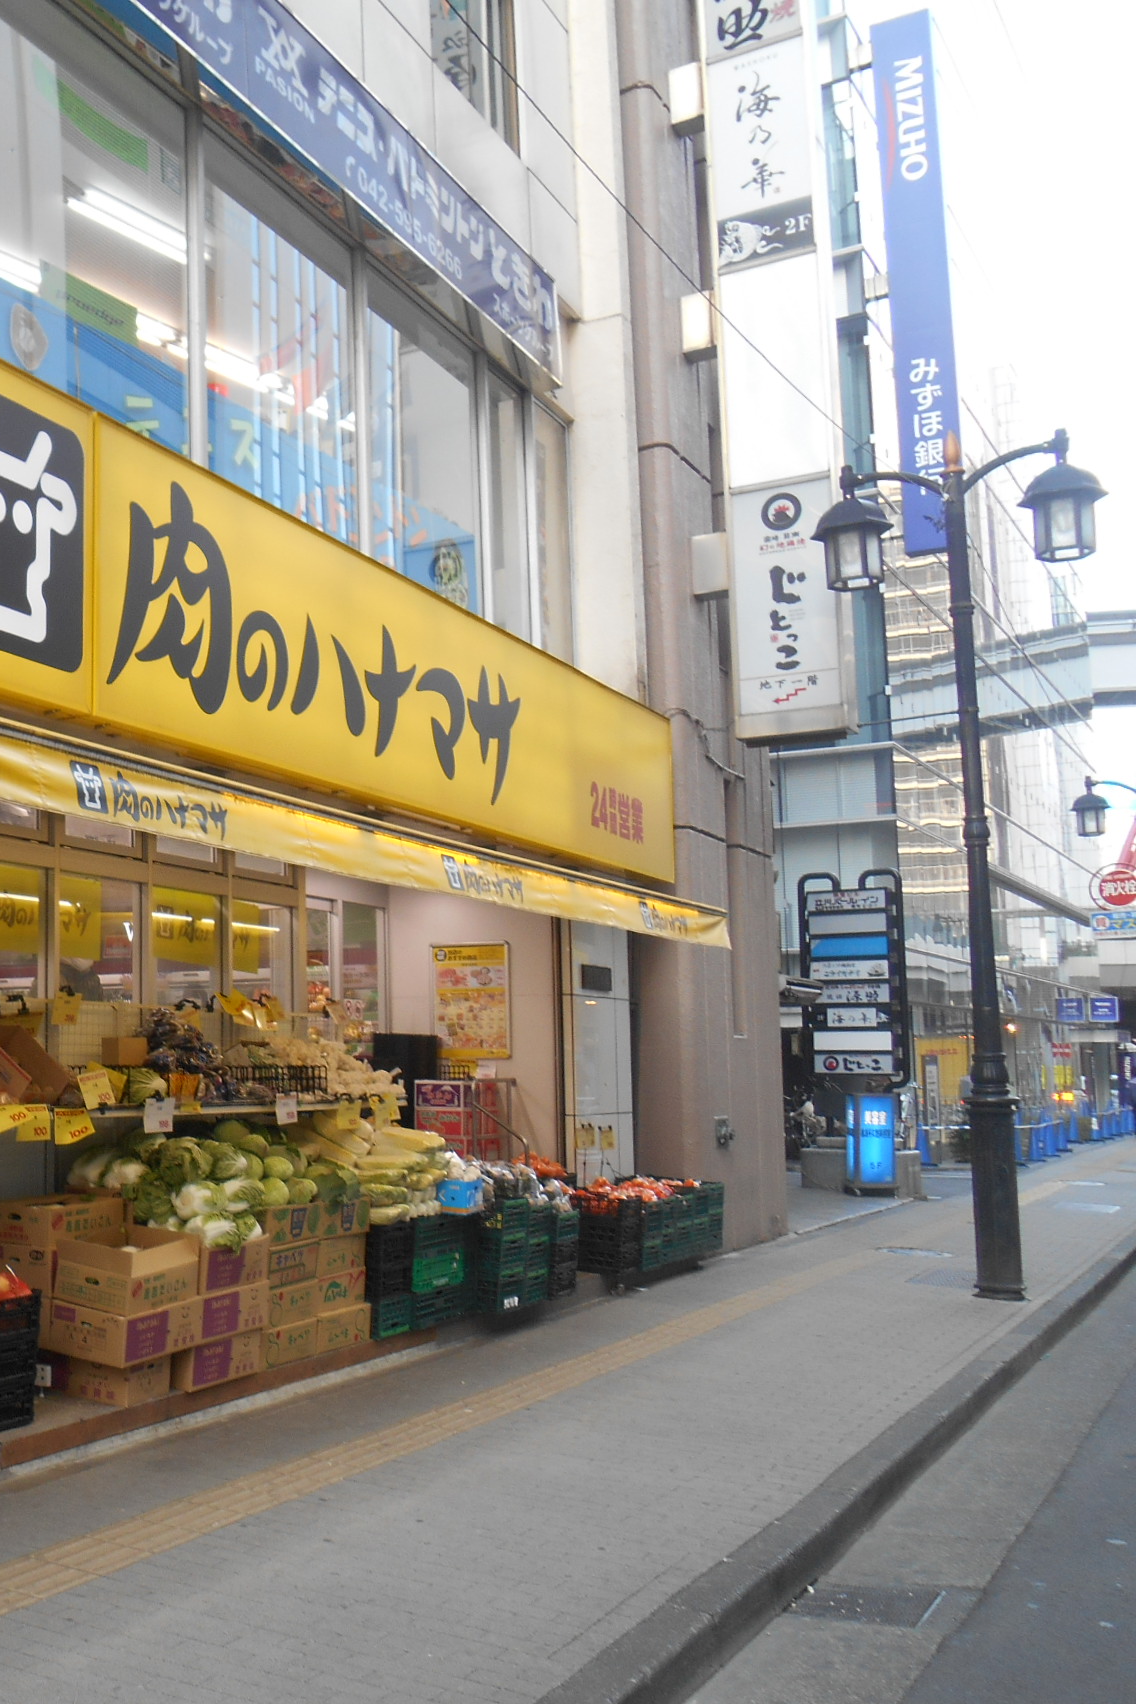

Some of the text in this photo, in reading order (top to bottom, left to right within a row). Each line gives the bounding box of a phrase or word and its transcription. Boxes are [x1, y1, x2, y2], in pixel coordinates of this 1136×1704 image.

[893, 55, 929, 182] MIZUHO
[357, 166, 463, 281] 042-595-6266
[784, 213, 813, 235] 2F
[107, 481, 521, 806] 肉のハナマサ
[768, 564, 807, 671] じとっこ
[758, 674, 819, 691] 地下一階
[110, 769, 229, 840] 肉のハナマサ
[463, 857, 524, 903] 肉のハナマサ
[9, 1111, 27, 1123] 100
[69, 1126, 89, 1139] 100
